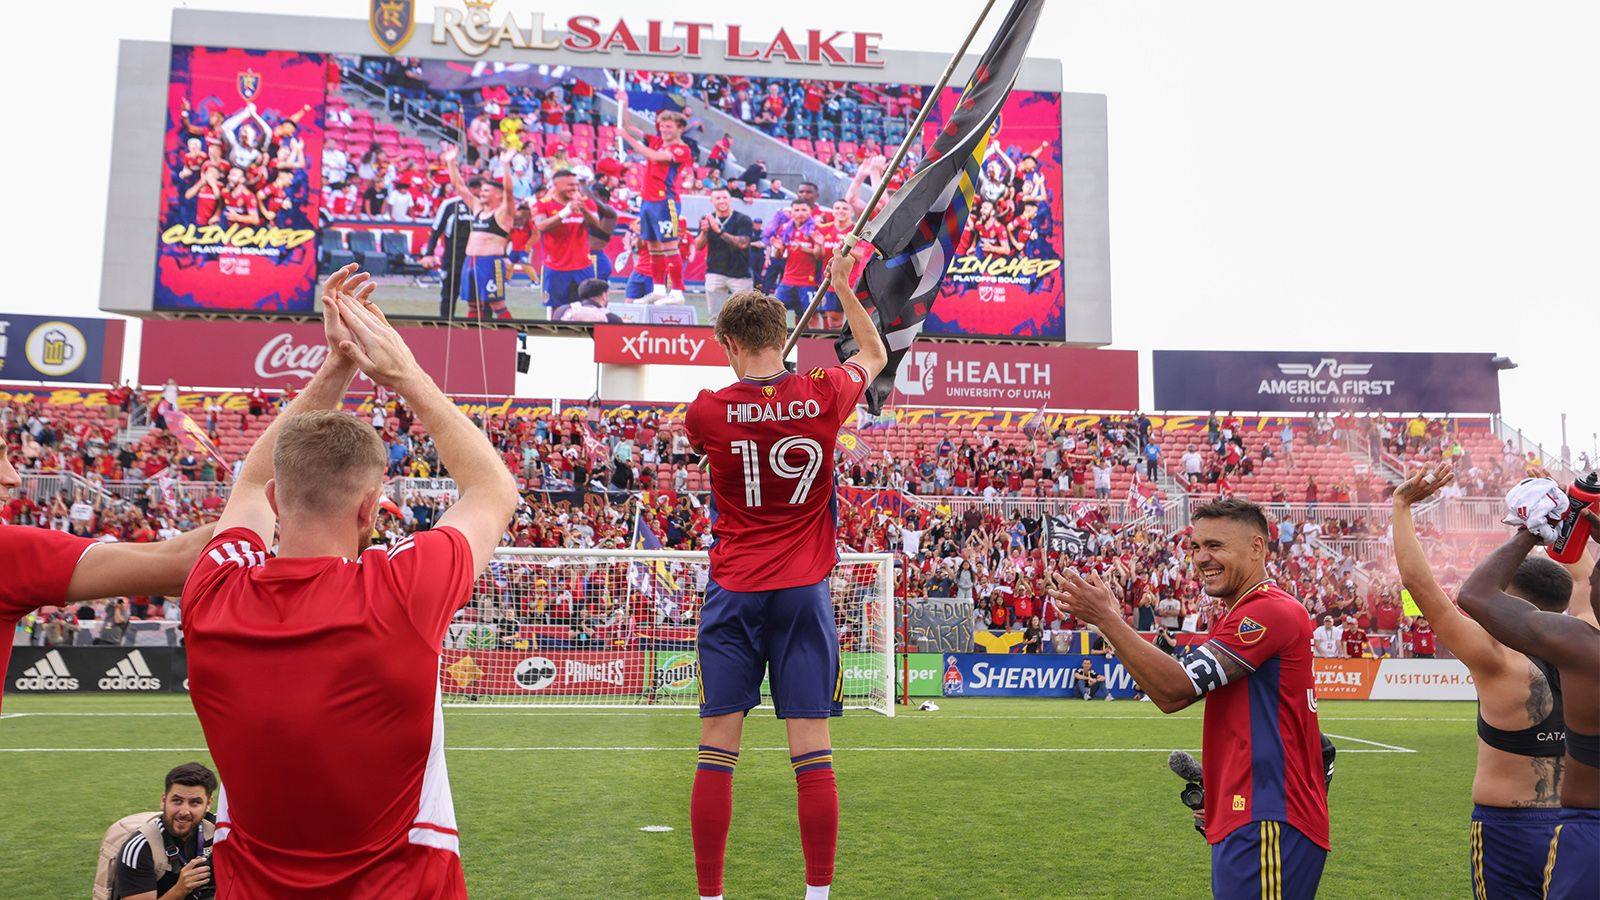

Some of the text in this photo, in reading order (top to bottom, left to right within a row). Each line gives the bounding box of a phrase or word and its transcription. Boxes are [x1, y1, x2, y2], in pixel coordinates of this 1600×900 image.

[562, 15, 713, 59] SALT
[725, 24, 885, 68] LAKE
[161, 222, 315, 249] CLINCHED
[947, 253, 1061, 278] LINCHED
[953, 274, 1031, 285] PLAYOFFS BOUND!
[621, 330, 705, 361] xfinity
[946, 360, 1051, 385] HEALTH
[946, 387, 1051, 399] UNIVERSITY OF UTAH
[1257, 379, 1395, 395] AMERICA FIRST
[727, 399, 820, 423] HIDALGO
[1290, 396, 1365, 404] CREDIT UNION
[730, 435, 823, 507] 19
[565, 659, 625, 686] PRINGLES
[654, 660, 699, 689] Bount
[1186, 659, 1212, 680] C
[15, 677, 80, 690] adidas
[98, 677, 161, 690] adidas
